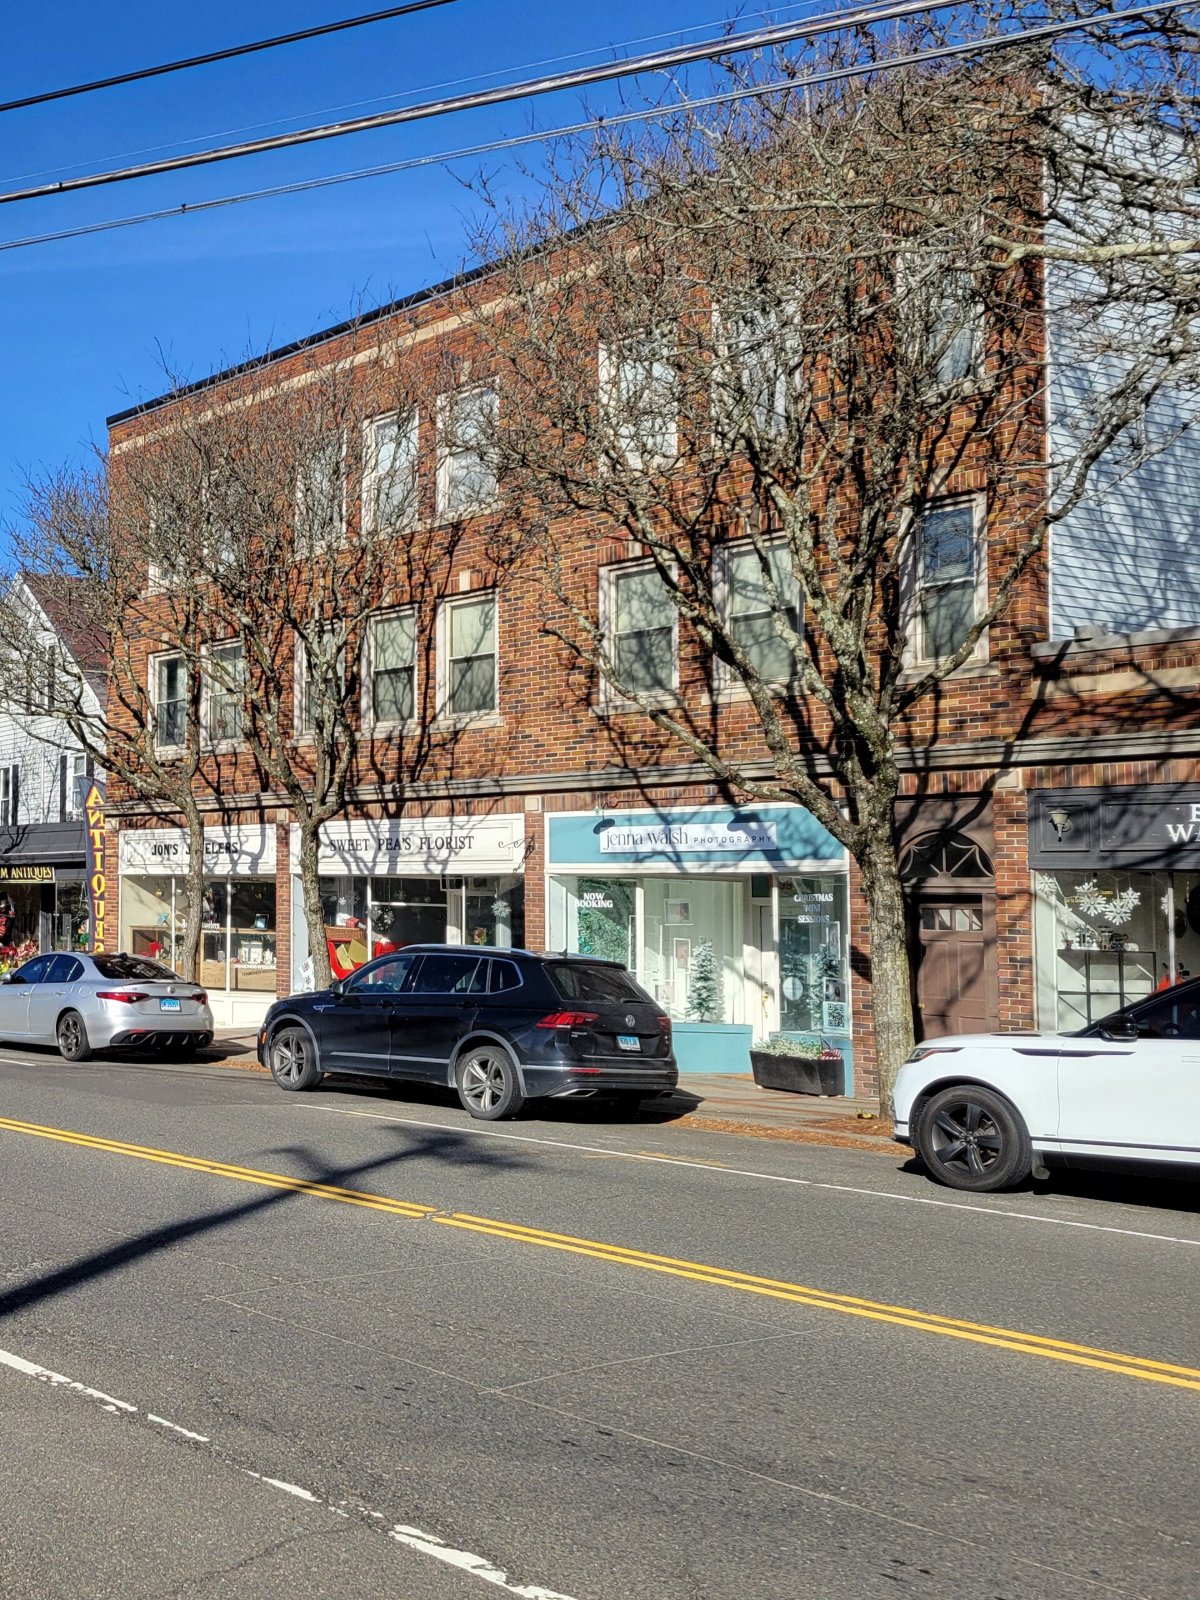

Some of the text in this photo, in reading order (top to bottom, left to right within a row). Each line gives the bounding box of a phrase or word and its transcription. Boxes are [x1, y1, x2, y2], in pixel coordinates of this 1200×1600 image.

[330, 835, 475, 851] SWEET PEA'S FLORIST
[603, 827, 772, 850] jenna walsh PHOTOGRAPHY
[151, 842, 238, 855] JON'S JELERS
[11, 866, 52, 881] ANTIQUES
[583, 892, 605, 900] NOW
[794, 893, 834, 902] CHRISTMAS
[575, 899, 614, 908] BOOKING
[804, 904, 821, 912] MINI
[798, 915, 830, 923] SESSIONS
